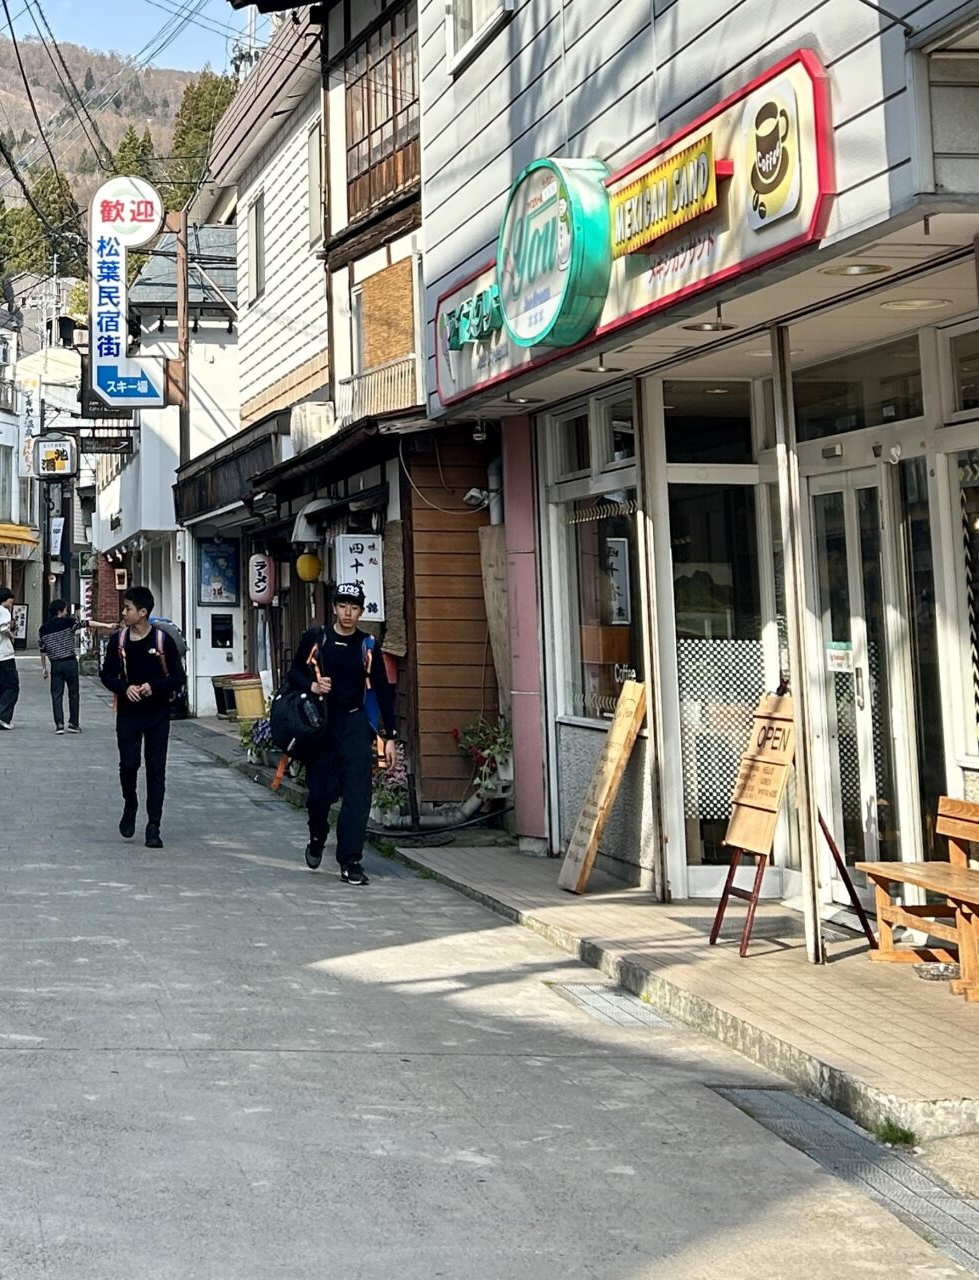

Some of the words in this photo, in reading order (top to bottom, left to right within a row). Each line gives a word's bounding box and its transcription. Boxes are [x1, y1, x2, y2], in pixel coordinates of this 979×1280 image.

[99, 198, 156, 224] 歓迎
[615, 177, 669, 247] MEXICAN
[671, 152, 710, 216] SAND
[96, 235, 121, 359] 松葉民宿街
[106, 379, 150, 394] スキー場
[253, 561, 268, 594] ラーメン
[757, 725, 791, 752] OPEN
